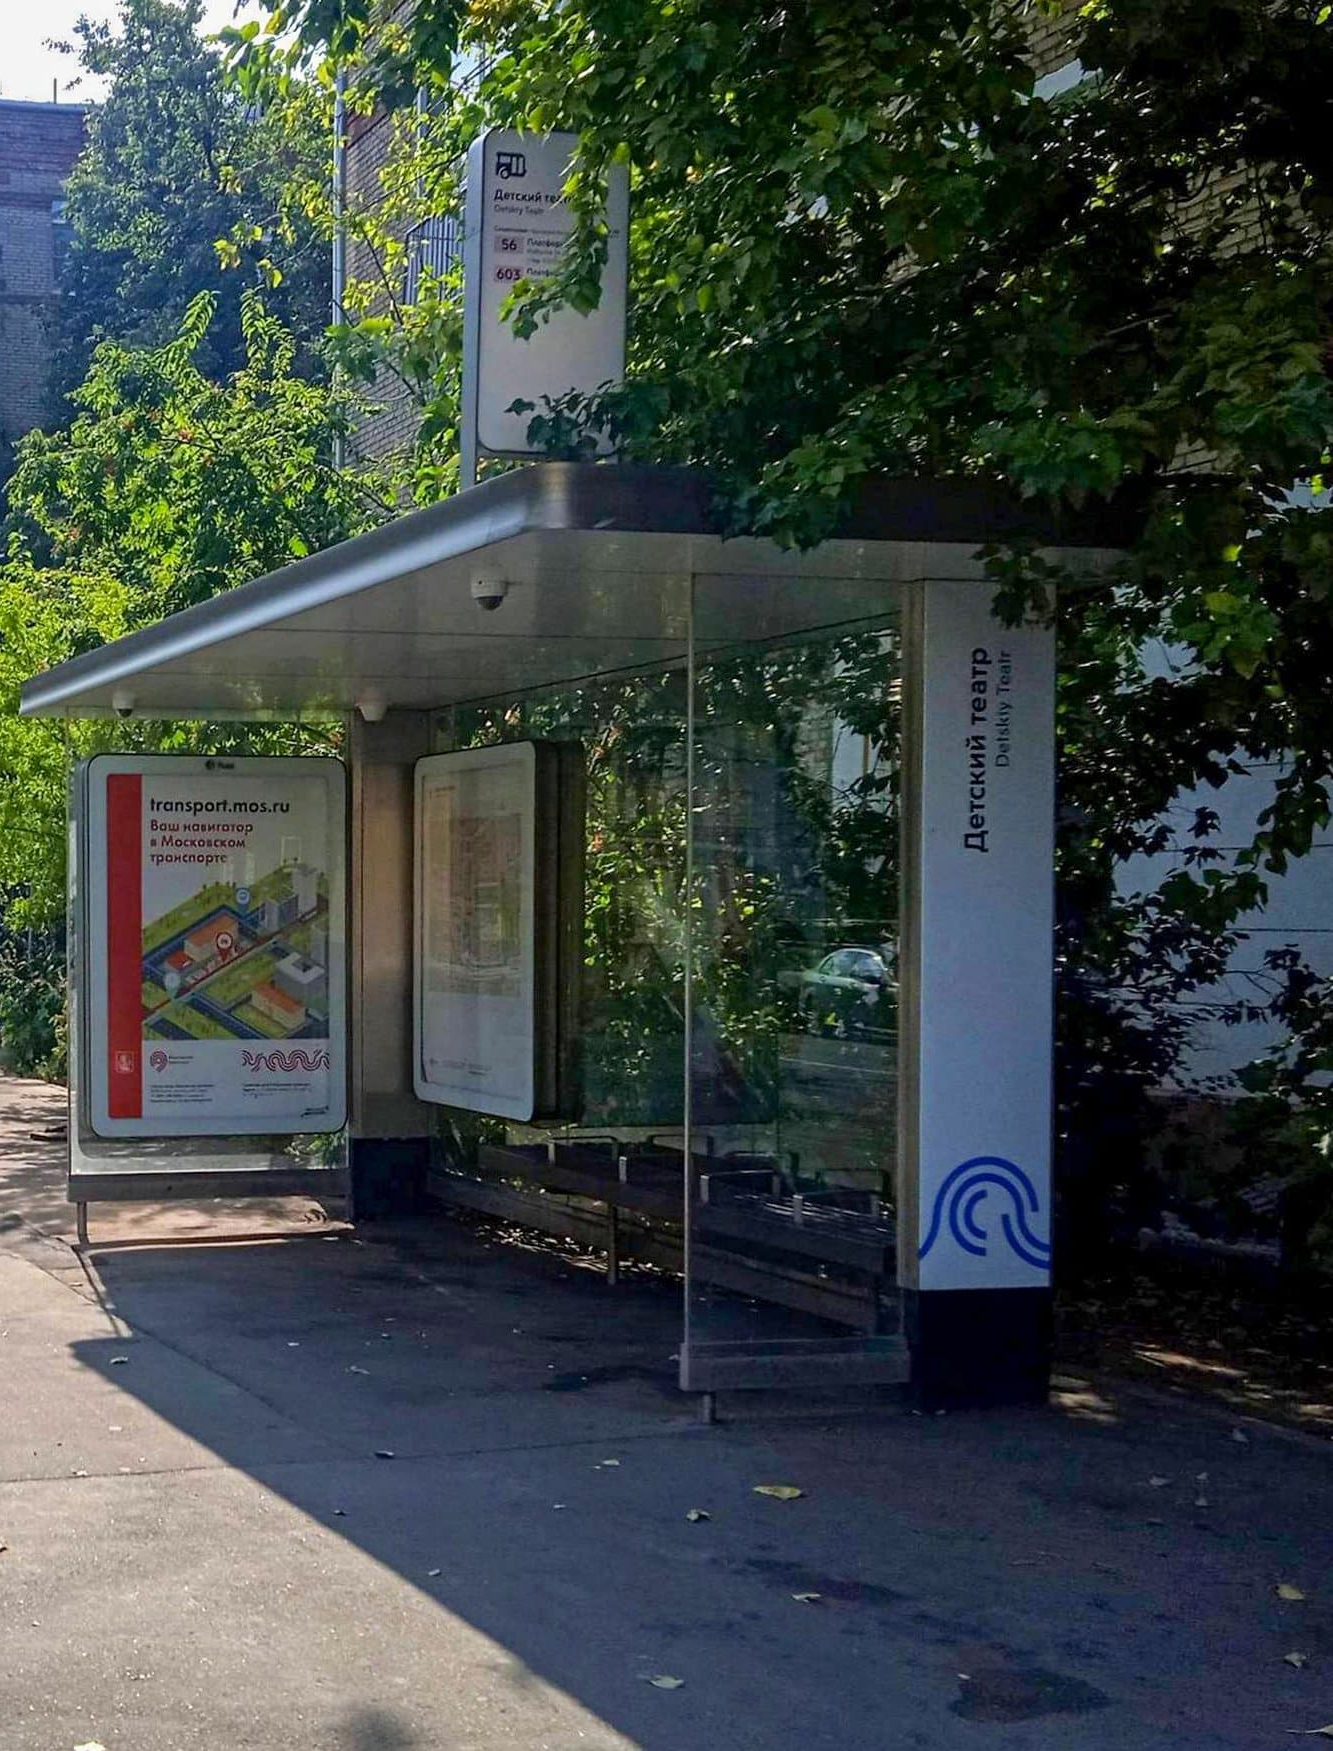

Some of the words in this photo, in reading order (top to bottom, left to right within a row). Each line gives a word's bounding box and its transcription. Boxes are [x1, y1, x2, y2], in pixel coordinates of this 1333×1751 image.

[494, 189, 542, 202] Детский
[501, 238, 517, 251] 56
[496, 267, 521, 281] 603
[996, 650, 1012, 695] Teatr
[971, 647, 992, 725] театр
[995, 700, 1013, 768] Detskiy
[963, 735, 989, 853] Детский
[150, 798, 290, 816] transport.mos.ru
[150, 819, 179, 832] Ваш
[183, 823, 254, 836] навигатор
[150, 838, 156, 847] в
[161, 835, 246, 848] Московском
[150, 853, 227, 866] транспорте
